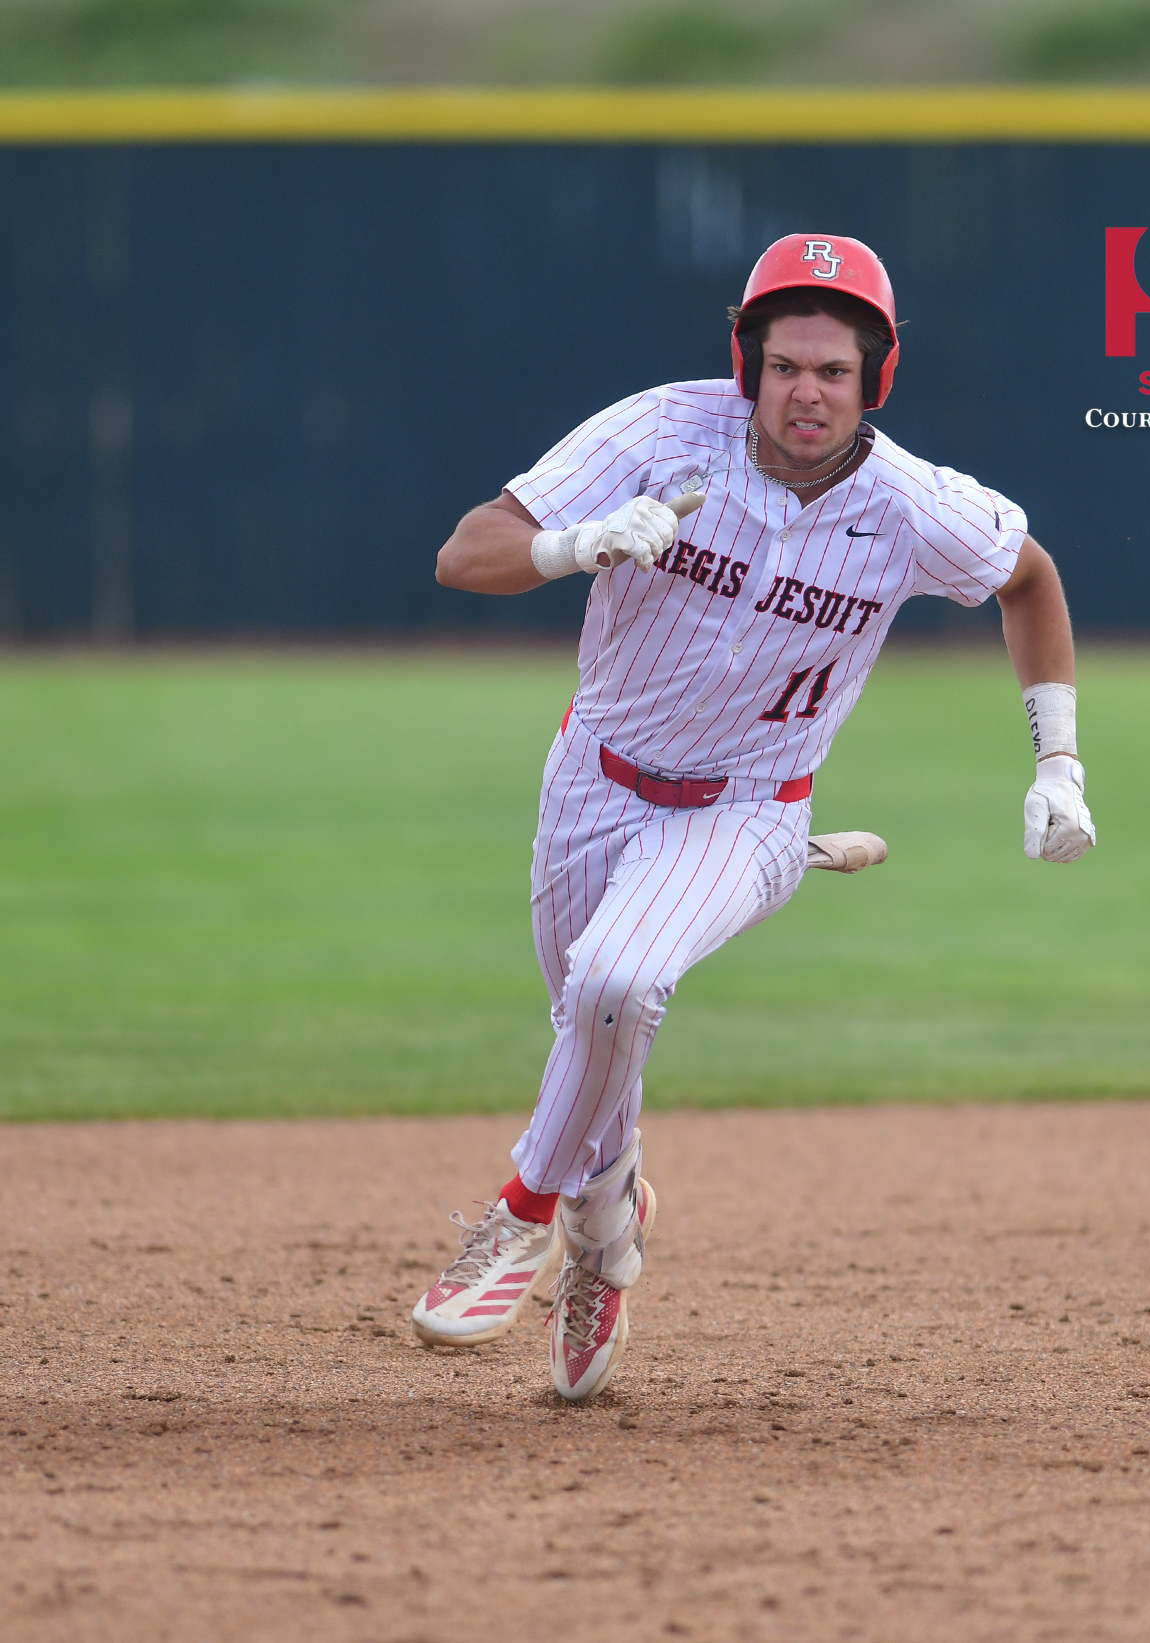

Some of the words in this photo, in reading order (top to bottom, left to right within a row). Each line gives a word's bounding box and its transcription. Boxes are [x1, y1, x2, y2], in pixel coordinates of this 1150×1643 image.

[802, 239, 842, 280] RJ
[754, 575, 884, 635] JESUIT
[758, 656, 841, 723] 11
